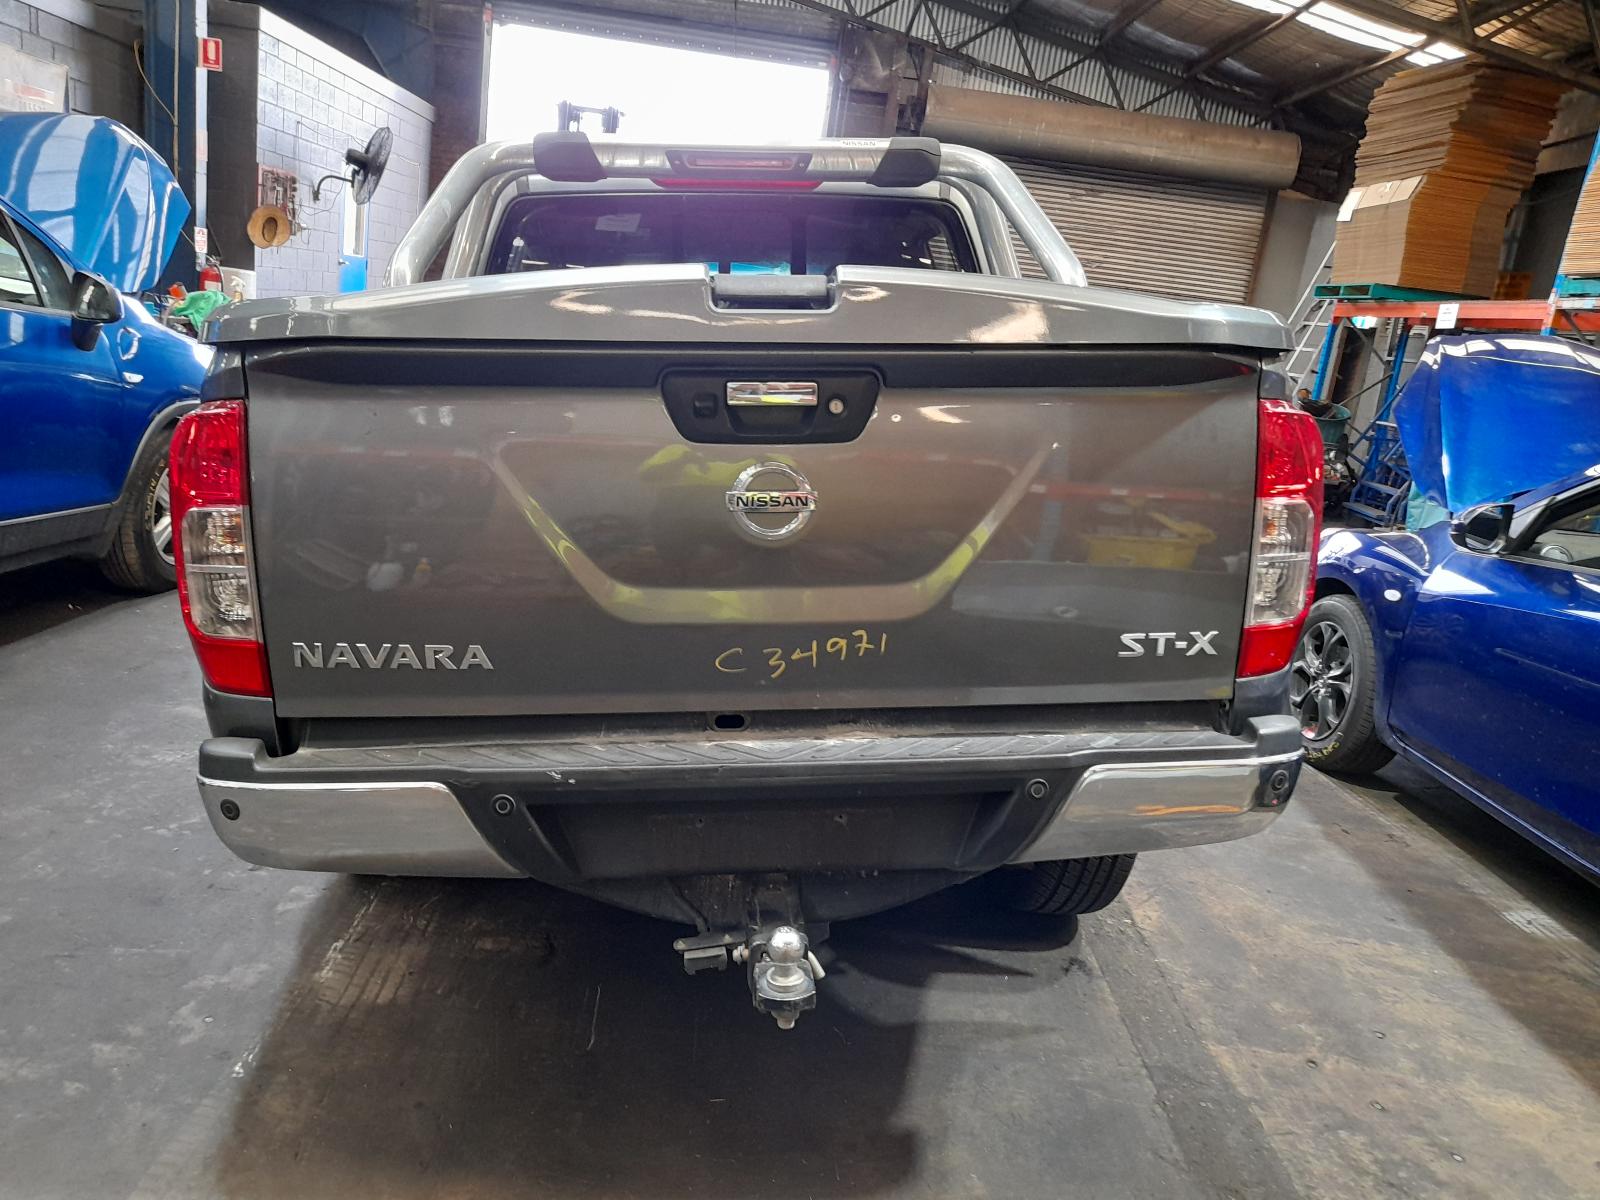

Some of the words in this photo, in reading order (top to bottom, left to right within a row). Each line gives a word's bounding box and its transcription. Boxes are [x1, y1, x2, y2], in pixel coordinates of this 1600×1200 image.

[736, 496, 808, 507] NISSAN
[292, 642, 494, 670] NAVARA
[715, 647, 748, 673] C
[762, 629, 888, 680] 34971
[1118, 630, 1219, 658] ST-X
